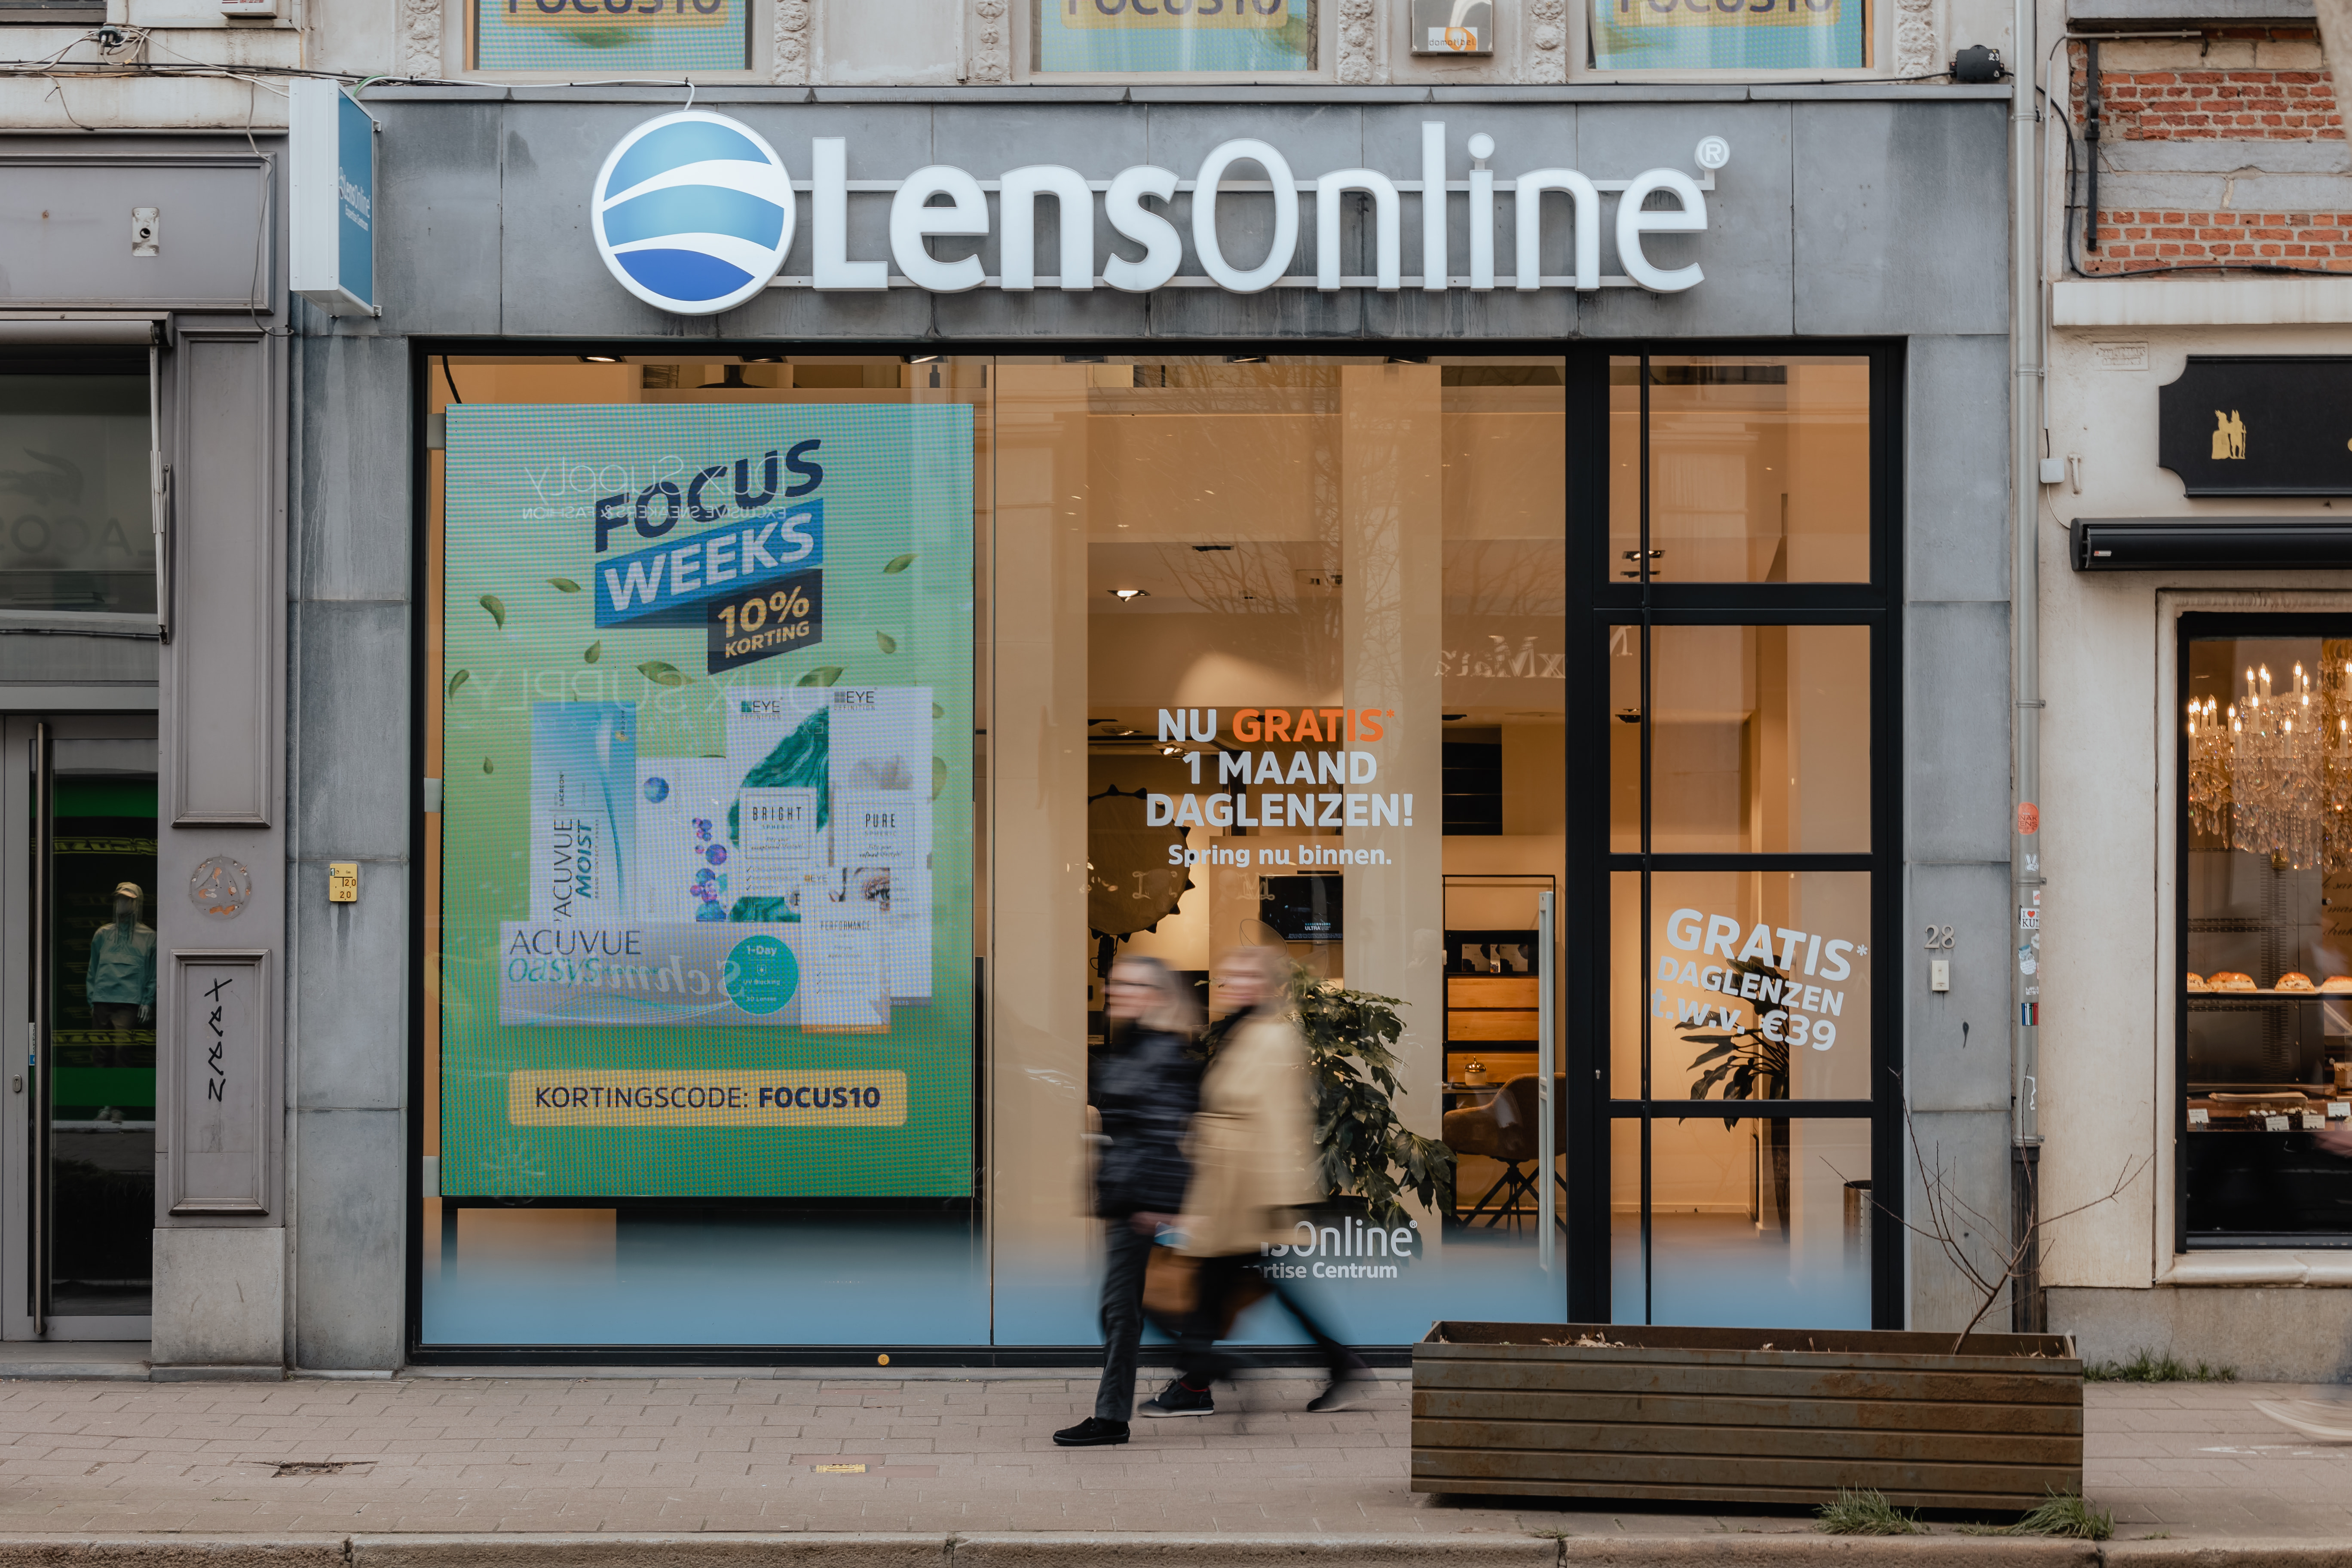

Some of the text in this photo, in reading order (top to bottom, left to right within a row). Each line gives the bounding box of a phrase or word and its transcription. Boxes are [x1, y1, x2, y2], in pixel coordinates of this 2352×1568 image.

[595, 439, 824, 554] FOCUS
[603, 513, 815, 612] WEEKS
[716, 585, 810, 638] 10%
[724, 621, 810, 659] KORTING
[753, 700, 781, 713] EYE
[846, 691, 875, 704] EYE
[1158, 708, 1217, 742] NU
[1182, 751, 1378, 784] 1 MAAND
[753, 806, 802, 821] BRIGHT
[865, 813, 896, 828] PURE
[1147, 793, 1413, 827] DAGLENZEN!
[553, 818, 573, 918] ACUVUE
[575, 818, 592, 899] MOIST
[1168, 844, 1392, 868] Spring nu binnen.
[509, 929, 642, 956] ACUVUE
[746, 945, 778, 957] 1-Day
[1924, 924, 1956, 949] 28
[1656, 955, 1844, 1017] DAGLENZEN
[1651, 987, 1836, 1051] t.w.v. €39
[536, 1086, 881, 1109] KORTINGSCODE: FOCUS10
[1312, 1262, 1397, 1279] Centrum
